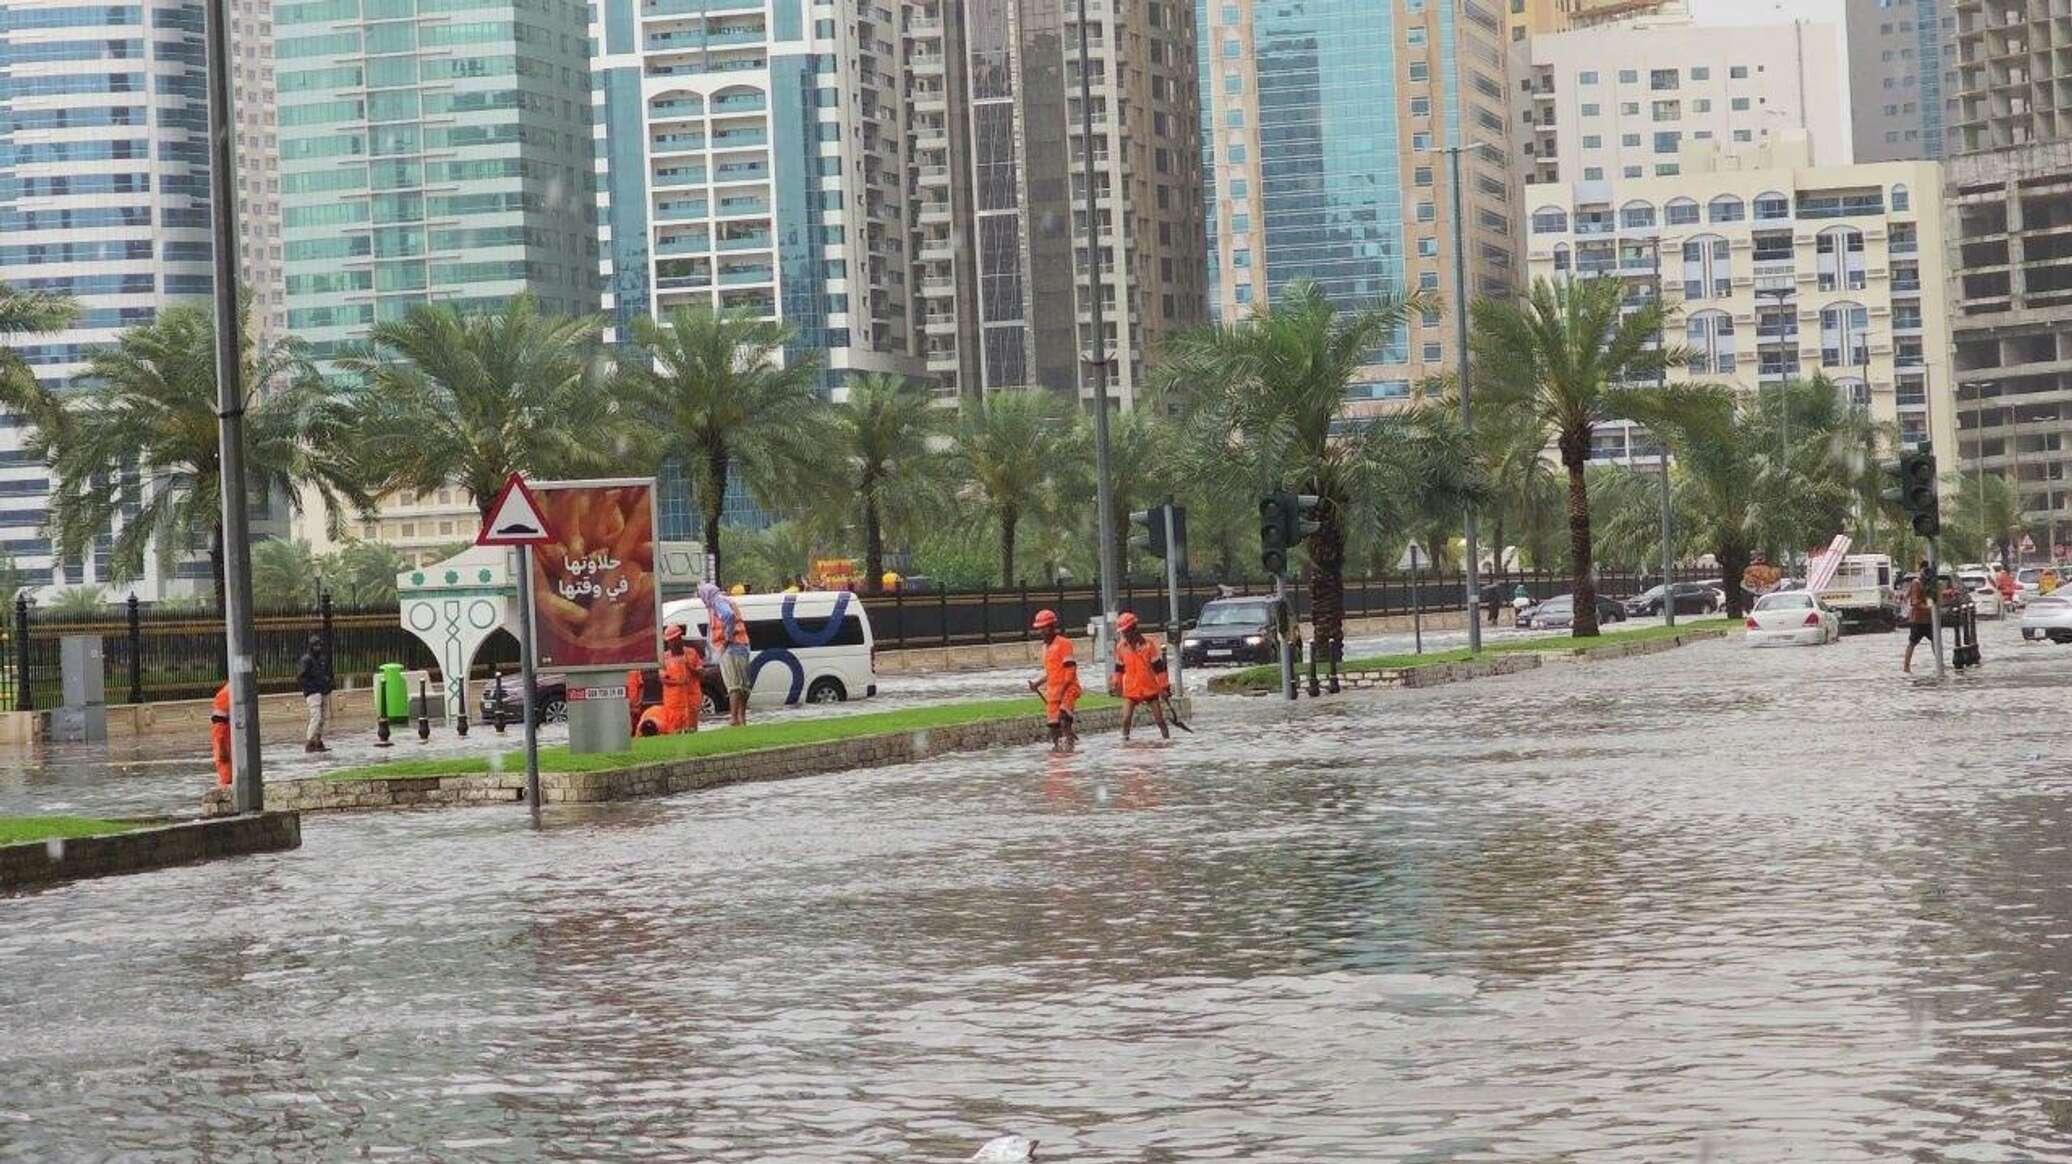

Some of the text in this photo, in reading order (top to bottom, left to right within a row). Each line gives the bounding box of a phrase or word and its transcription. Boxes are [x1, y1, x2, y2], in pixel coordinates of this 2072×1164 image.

[564, 554, 621, 575] حلاوتها
[559, 575, 628, 601] في وقتها
